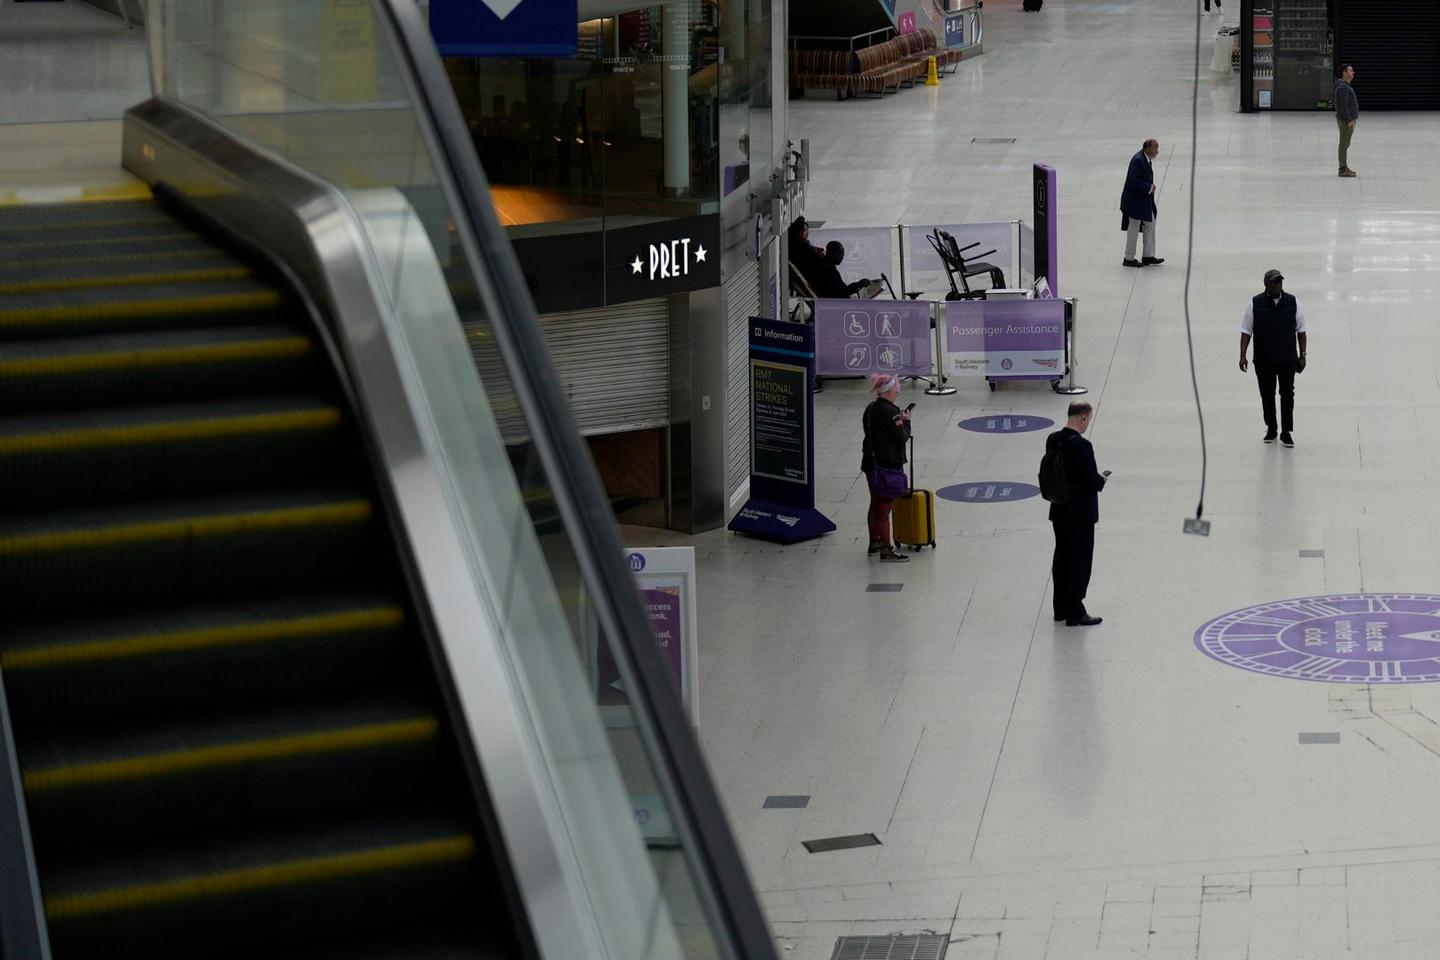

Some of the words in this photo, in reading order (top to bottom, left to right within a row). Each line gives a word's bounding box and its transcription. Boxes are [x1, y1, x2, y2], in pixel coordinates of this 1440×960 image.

[650, 238, 691, 281] PRET
[764, 329, 803, 343] Information
[952, 326, 1003, 337] Passenger
[1006, 324, 1060, 335] Assistance
[755, 368, 772, 380] RMT
[755, 381, 793, 395] NATIONAL
[755, 391, 788, 406] STRIKES
[646, 603, 671, 611] ccess
[1334, 620, 1359, 640] under
[1365, 621, 1389, 639] Meet
[1304, 628, 1328, 647] clock
[1335, 641, 1360, 653] the
[1366, 640, 1384, 652] me
